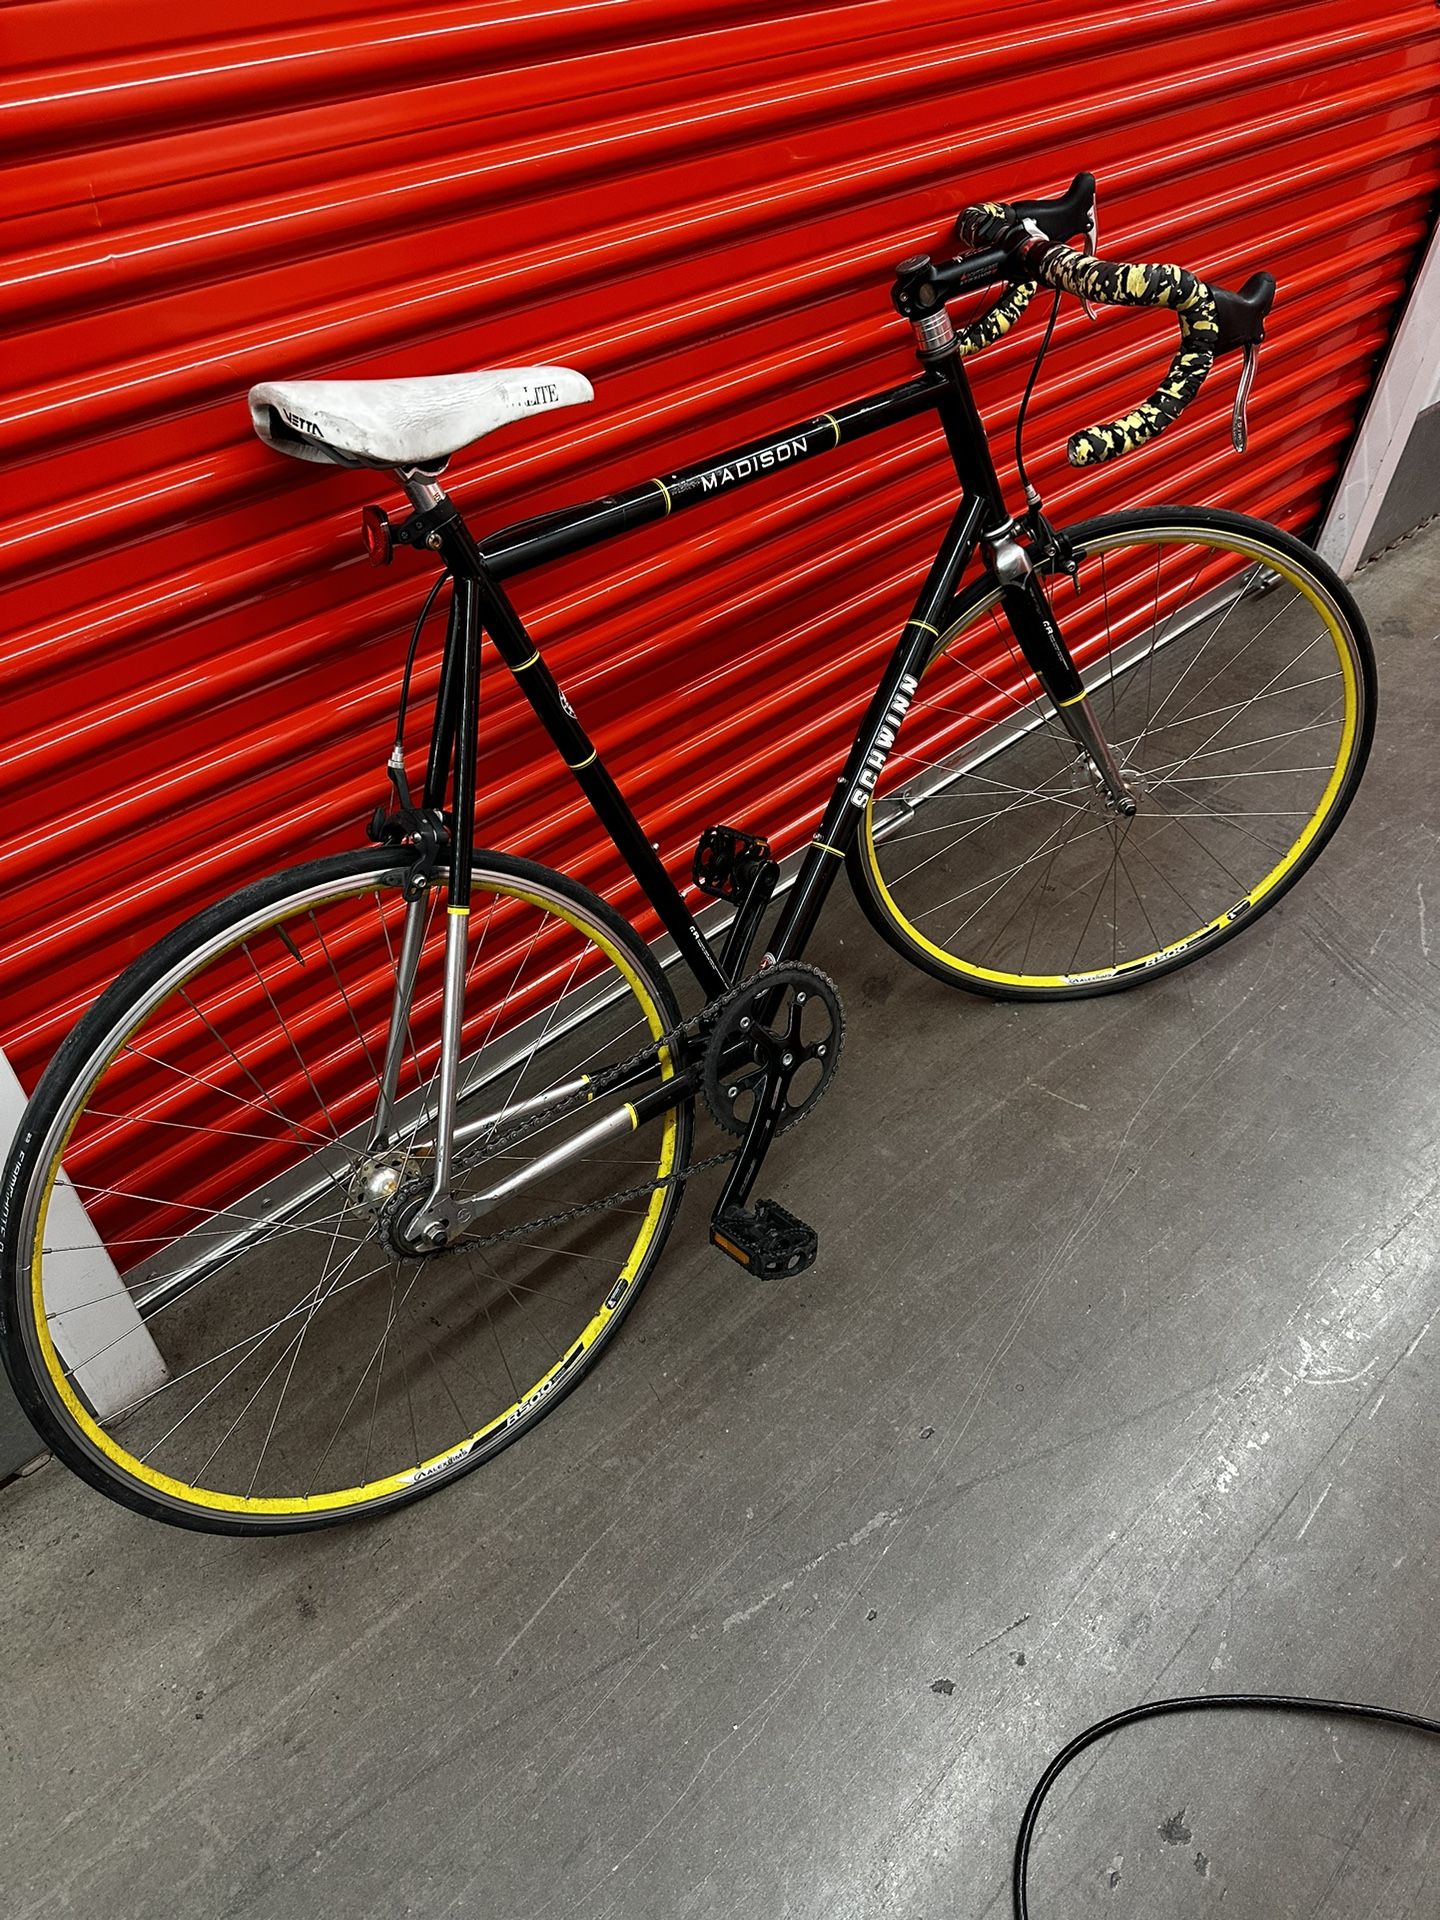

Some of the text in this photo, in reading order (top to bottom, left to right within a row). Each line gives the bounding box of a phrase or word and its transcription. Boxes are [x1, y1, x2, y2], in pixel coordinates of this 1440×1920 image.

[283, 408, 324, 438] VETTA
[701, 438, 808, 492] MADISON
[851, 673, 919, 808] SCHWINN
[507, 1381, 553, 1428] R500
